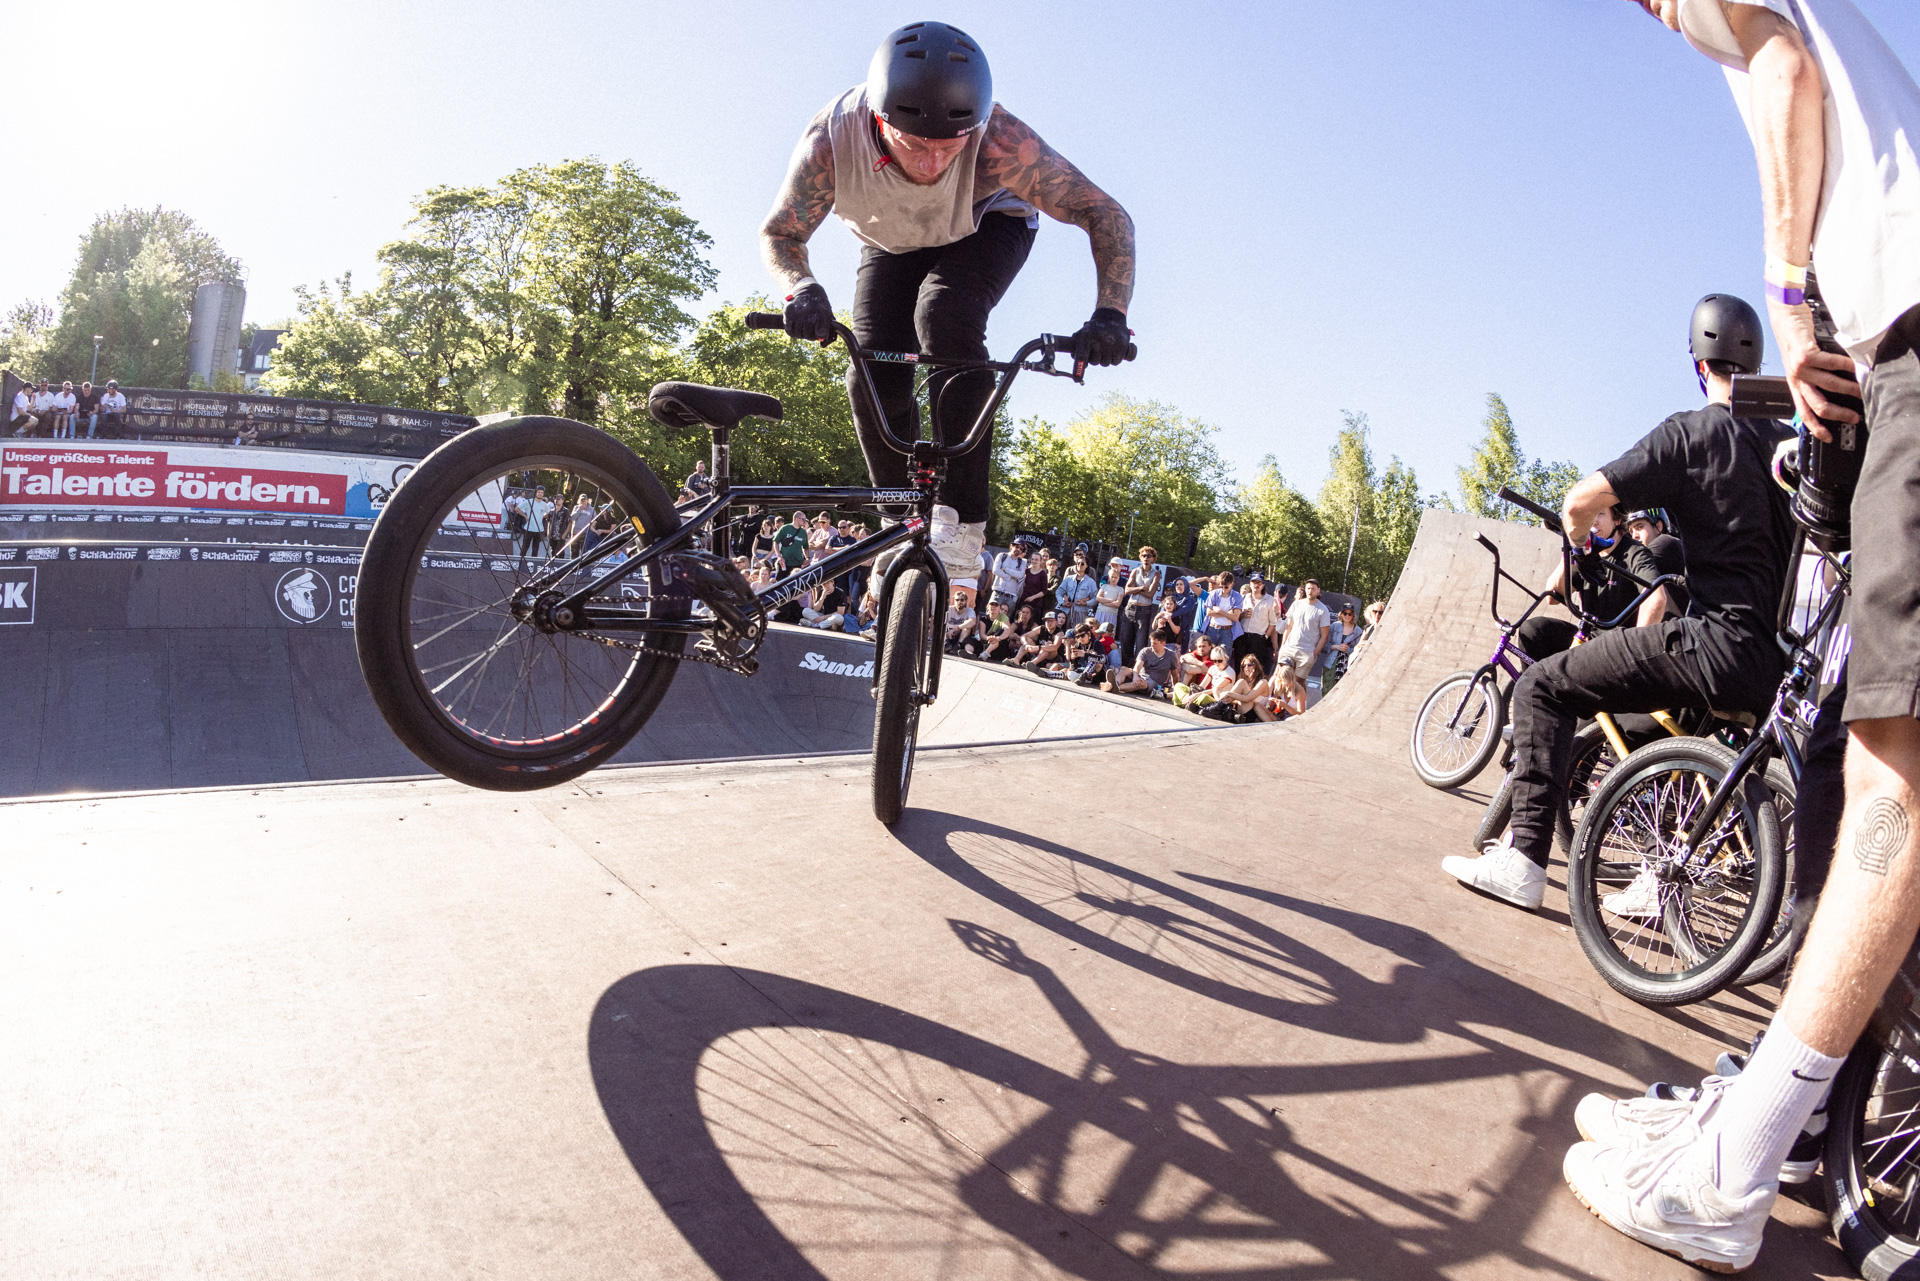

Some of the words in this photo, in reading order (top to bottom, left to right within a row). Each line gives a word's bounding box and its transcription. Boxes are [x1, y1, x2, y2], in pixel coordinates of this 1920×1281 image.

[254, 404, 286, 414] NAH.SH
[339, 420, 374, 428] FLENSBURG
[357, 415, 378, 423] HAFEN
[402, 417, 433, 428] NAH.SH
[5, 451, 47, 463] Unser
[49, 453, 105, 465] größtes
[108, 454, 155, 465] Talent:
[2, 467, 156, 498] Talente
[164, 471, 330, 505] fördern.
[765, 566, 823, 607] WIZARD
